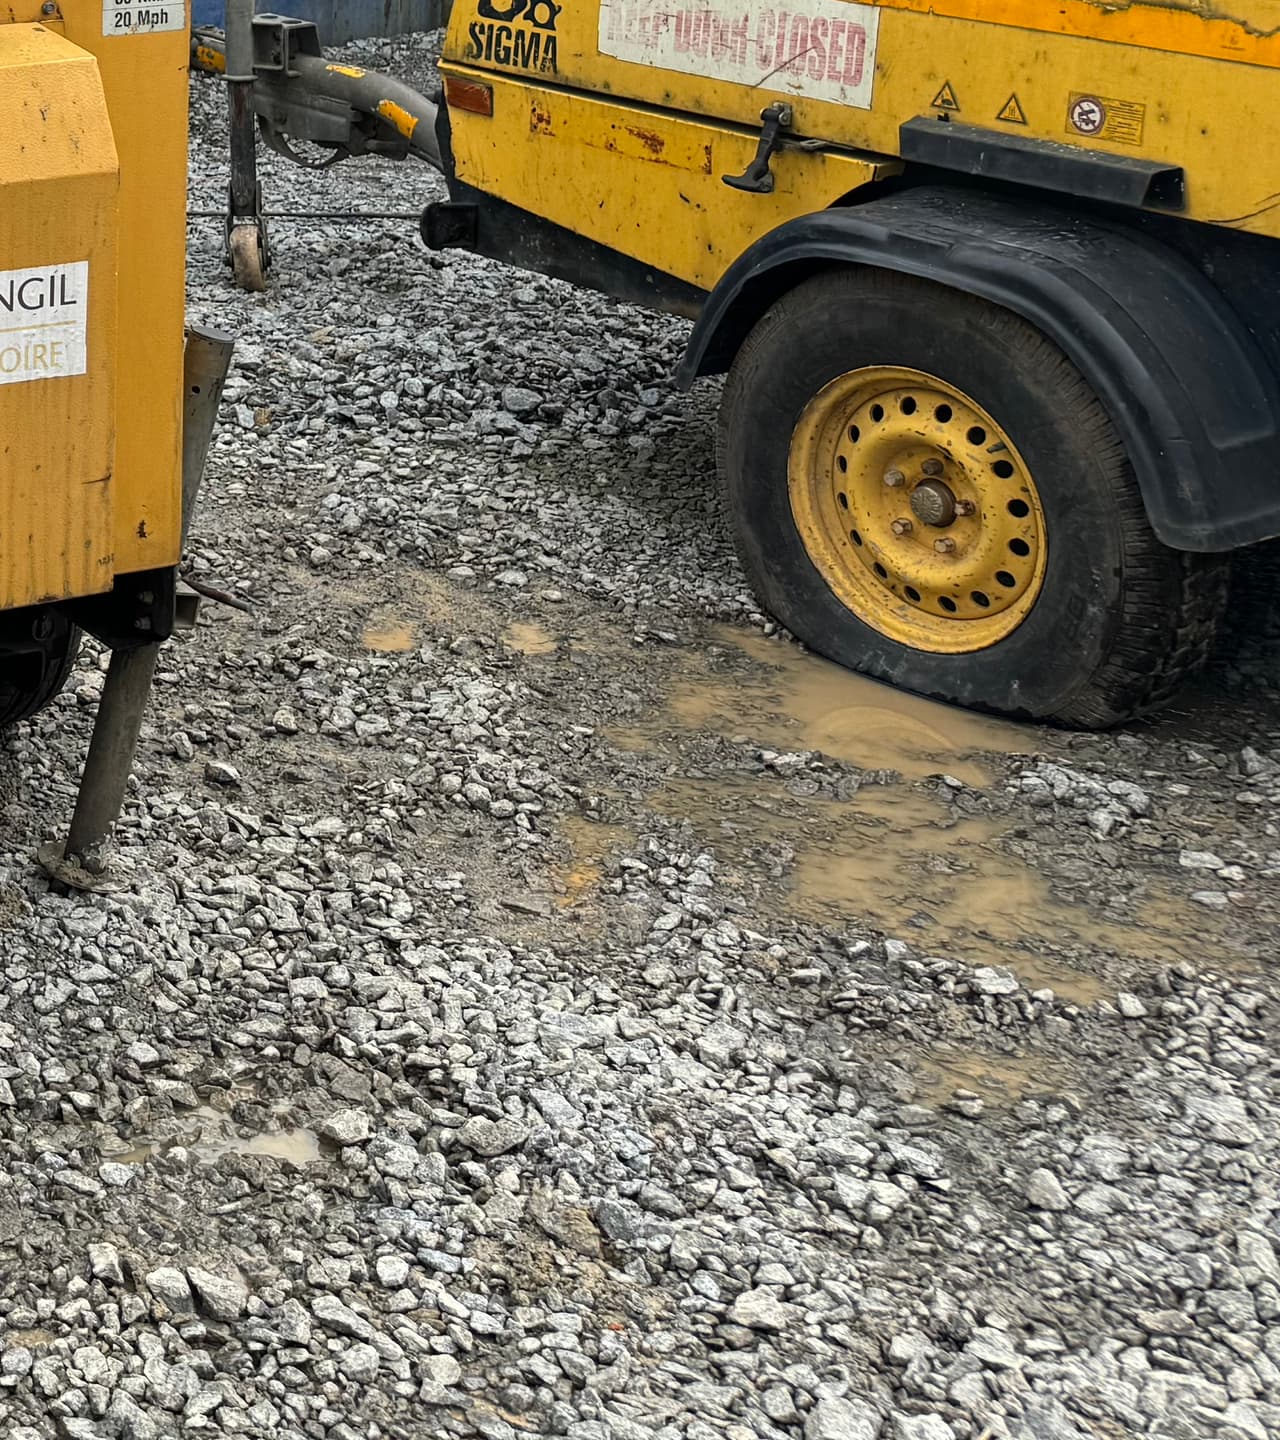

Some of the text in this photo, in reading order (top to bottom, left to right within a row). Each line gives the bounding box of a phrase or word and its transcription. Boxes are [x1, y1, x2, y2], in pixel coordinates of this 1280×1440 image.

[114, 8, 169, 29] 20 Mph
[468, 20, 558, 75] SIGMA
[756, 10, 867, 88] CLOSED
